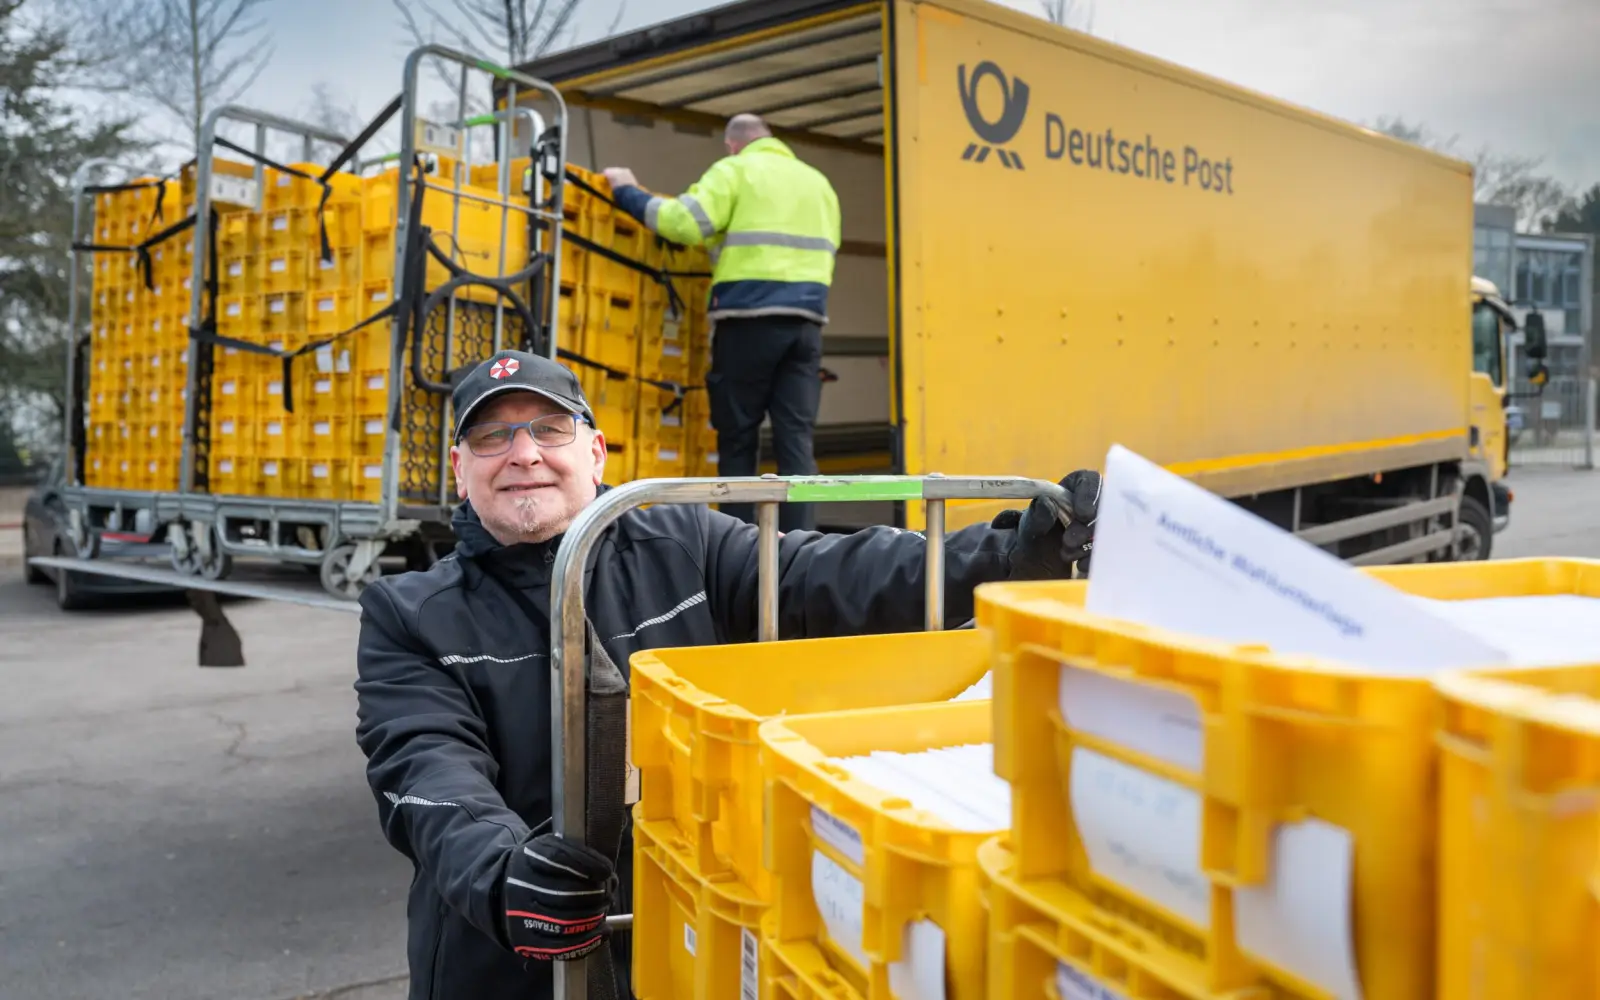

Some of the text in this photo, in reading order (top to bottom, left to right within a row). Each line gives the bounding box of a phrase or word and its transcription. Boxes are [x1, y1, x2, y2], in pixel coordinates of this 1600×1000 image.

[1045, 111, 1234, 195] Deutsche Post
[1156, 510, 1227, 560] Amtliche
[523, 919, 560, 934] STRAUSS
